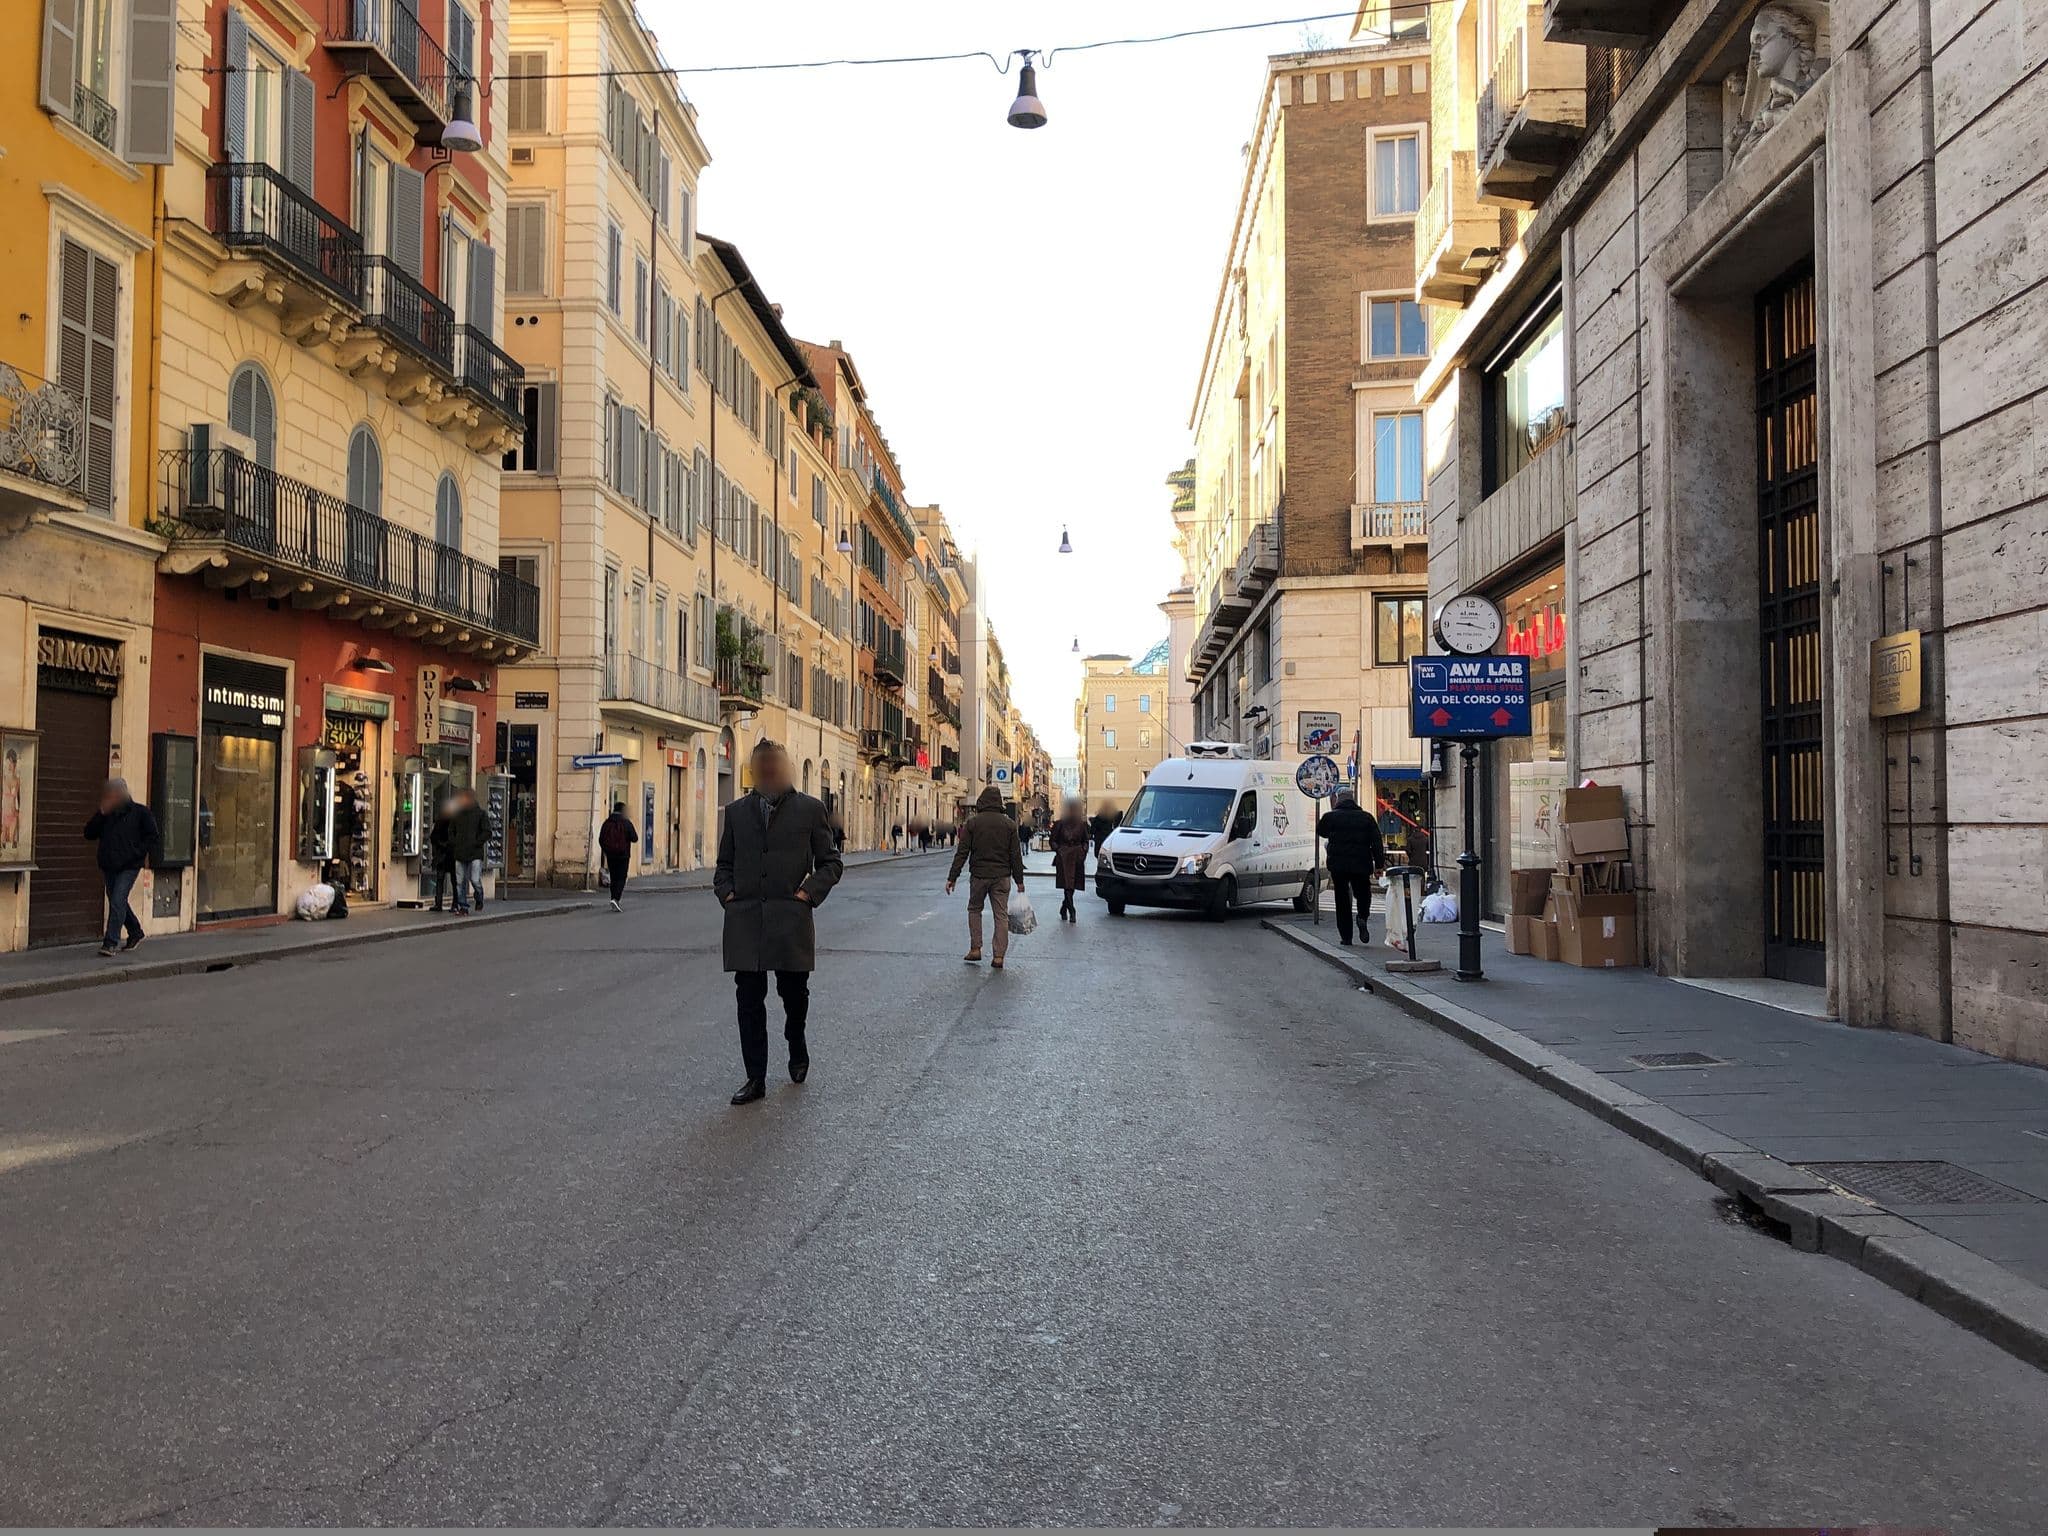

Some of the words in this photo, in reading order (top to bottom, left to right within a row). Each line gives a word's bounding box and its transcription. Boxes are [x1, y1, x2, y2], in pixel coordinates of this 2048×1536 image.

[1466, 600, 1476, 608] 12
[1444, 620, 1450, 628] 9
[1489, 621, 1496, 629] 3
[38, 636, 124, 676] SIMONA
[1449, 663, 1481, 676] AW
[1488, 663, 1523, 676] LAB
[208, 687, 284, 712] intimissimi
[1420, 695, 1439, 704] VIA
[1442, 695, 1461, 704] DEL
[1463, 695, 1501, 704] CORSO
[1504, 695, 1525, 704] 505
[262, 713, 281, 726] uomo
[326, 716, 363, 734] saldi
[330, 730, 363, 747] 50%
[515, 740, 530, 748] TIM
